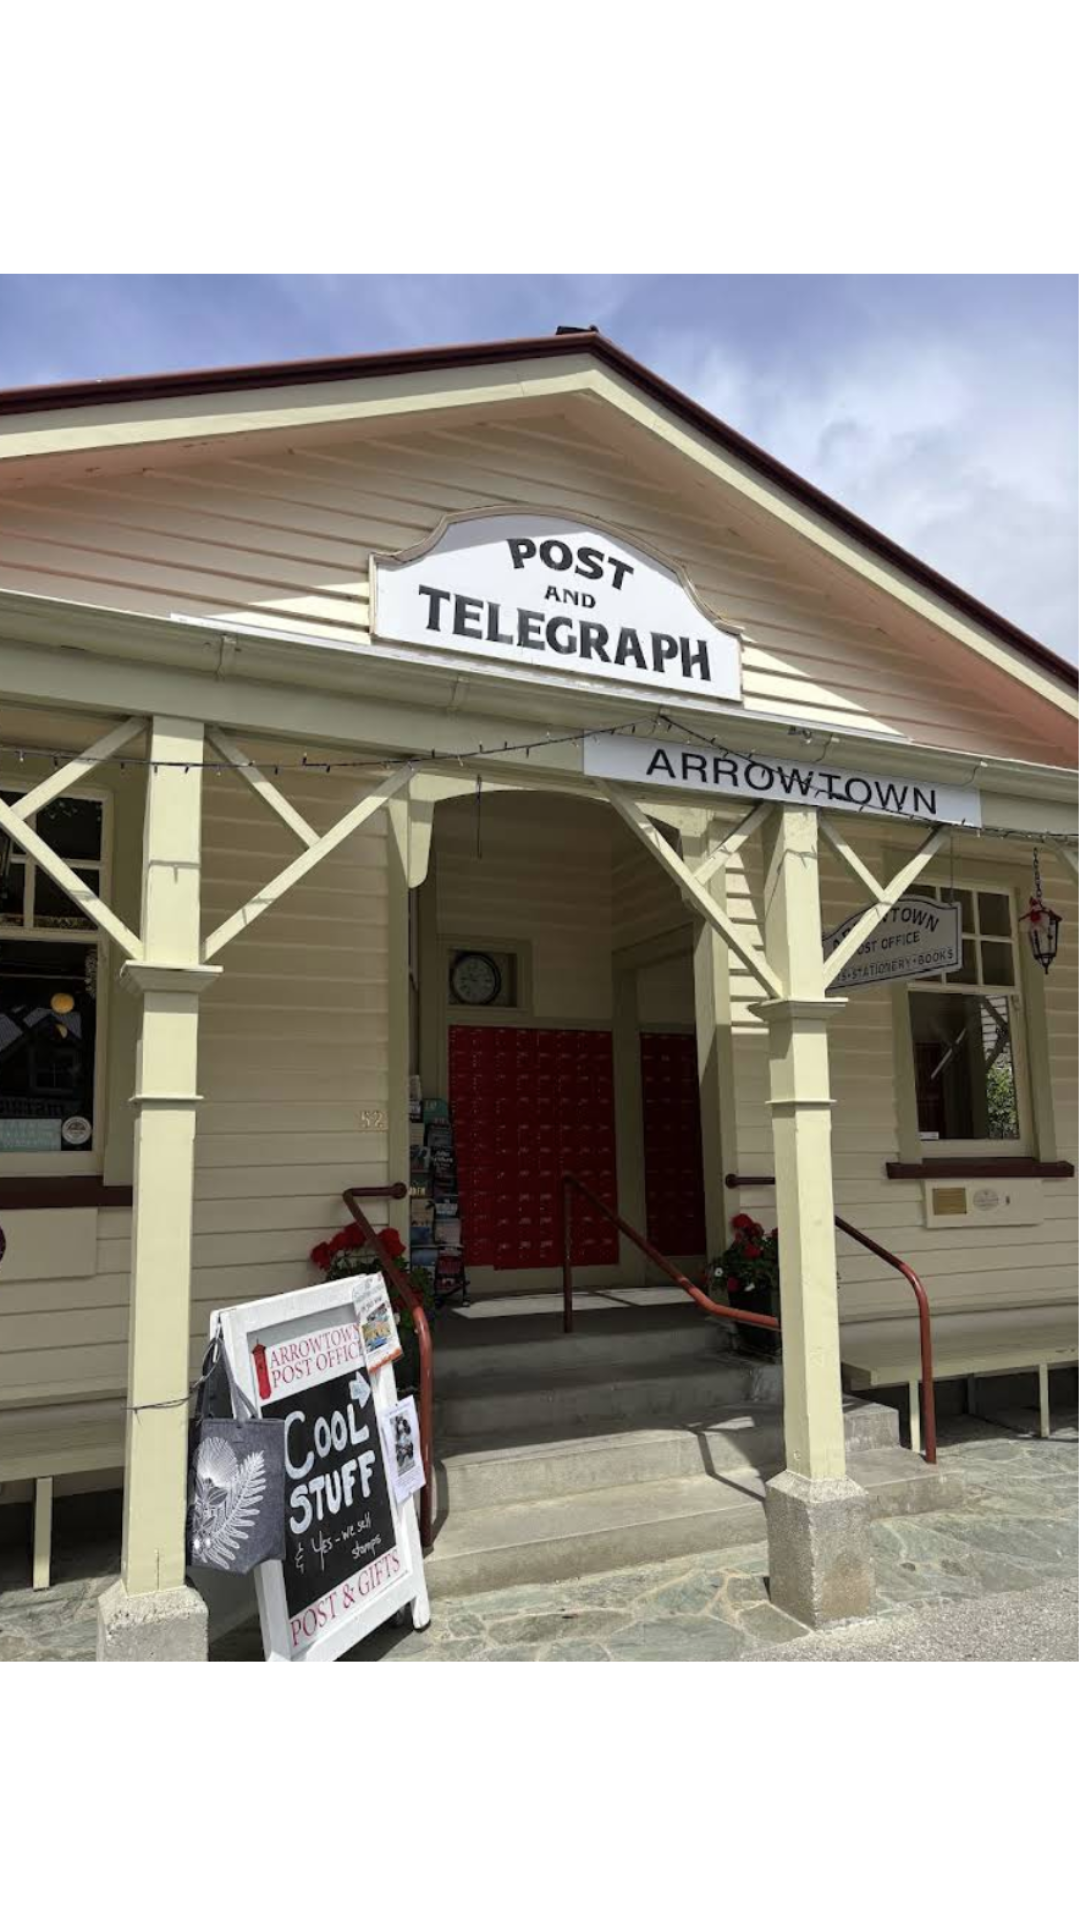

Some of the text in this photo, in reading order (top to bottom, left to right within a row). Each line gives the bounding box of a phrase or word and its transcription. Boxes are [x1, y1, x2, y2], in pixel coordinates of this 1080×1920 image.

[506, 537, 635, 591] POST
[544, 585, 597, 609] AND
[418, 584, 712, 682] TELEGRAPH
[646, 748, 937, 815] ARROWTOWN
[832, 906, 940, 949] ATOWN
[881, 931, 920, 950] OFFICE
[271, 1358, 313, 1388] POST
[289, 1450, 376, 1534] STUFF
[290, 1549, 402, 1648] POST & GIFTS
